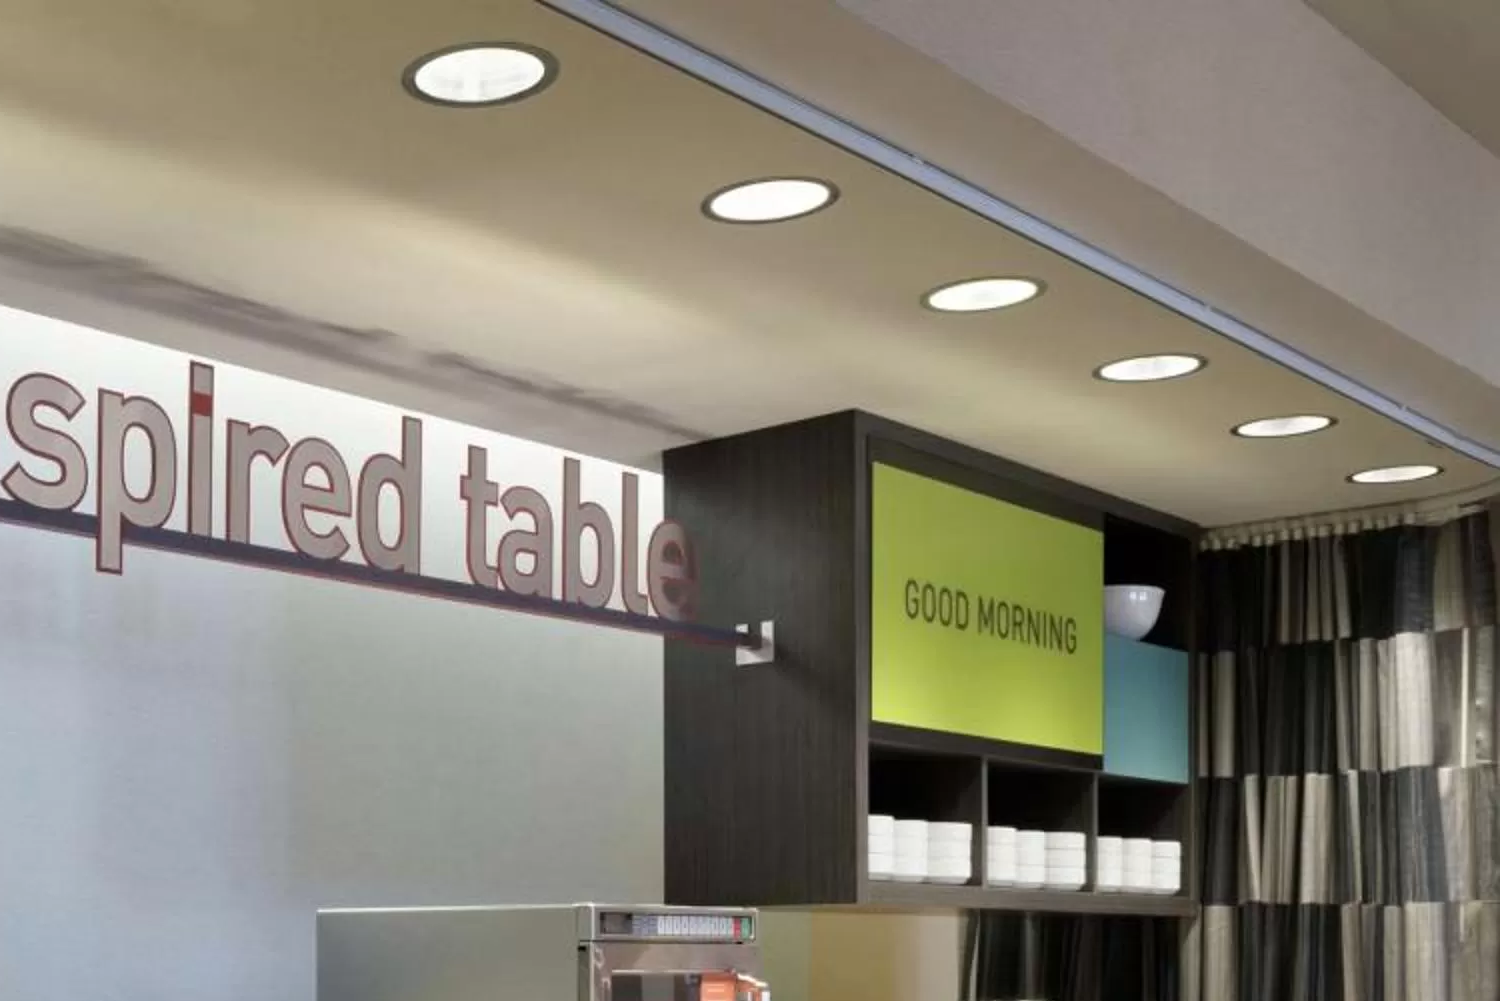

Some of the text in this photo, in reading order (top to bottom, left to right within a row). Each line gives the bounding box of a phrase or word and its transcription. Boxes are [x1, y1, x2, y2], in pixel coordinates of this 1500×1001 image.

[460, 443, 697, 624] table
[904, 577, 1078, 656] GOOD MORNING
